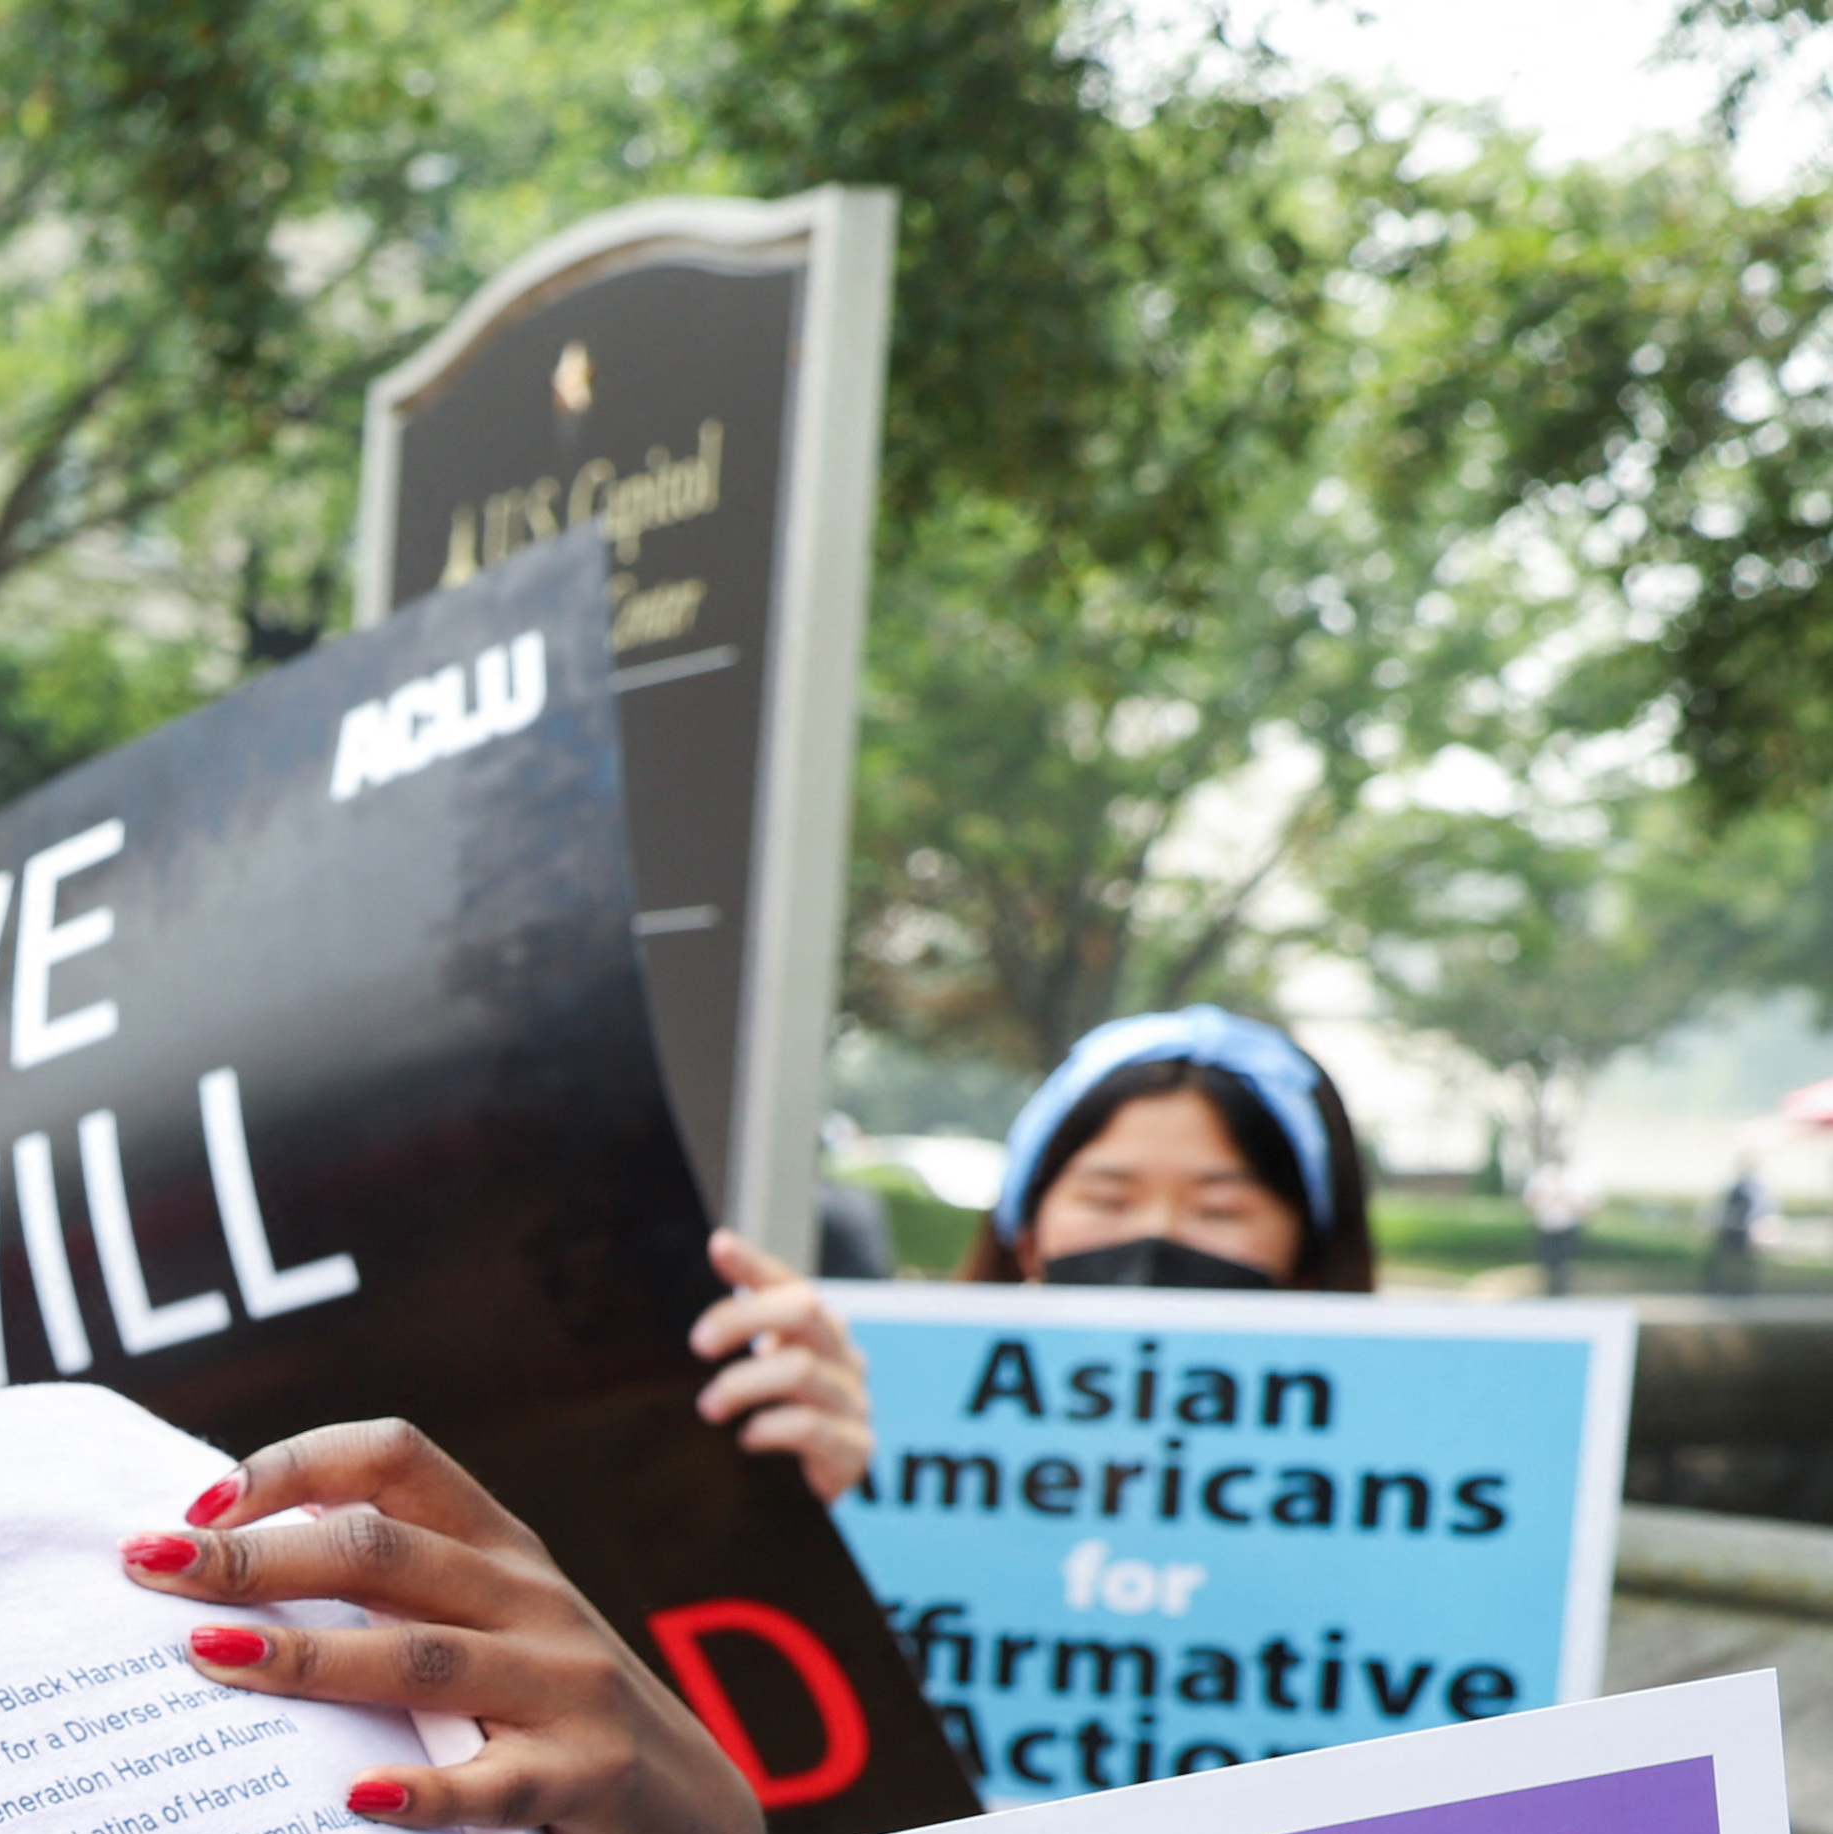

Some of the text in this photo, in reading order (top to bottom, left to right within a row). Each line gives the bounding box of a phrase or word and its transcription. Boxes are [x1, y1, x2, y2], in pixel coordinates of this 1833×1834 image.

[330, 628, 548, 802] ACLU
[965, 1340, 1337, 1432] Asian
[1063, 1537, 1209, 1618] for
[67, 1646, 168, 1689] Harvard
[881, 1600, 1521, 1724] firmative
[0, 1738, 41, 1765] for
[45, 1732, 66, 1751] a
[63, 1702, 163, 1744] Diverse
[110, 1734, 217, 1782] Harvard
[216, 1713, 300, 1750] Alumni
[162, 1795, 190, 1824] of
[188, 1765, 292, 1814] Harvard
[313, 1806, 366, 1833] Allia
